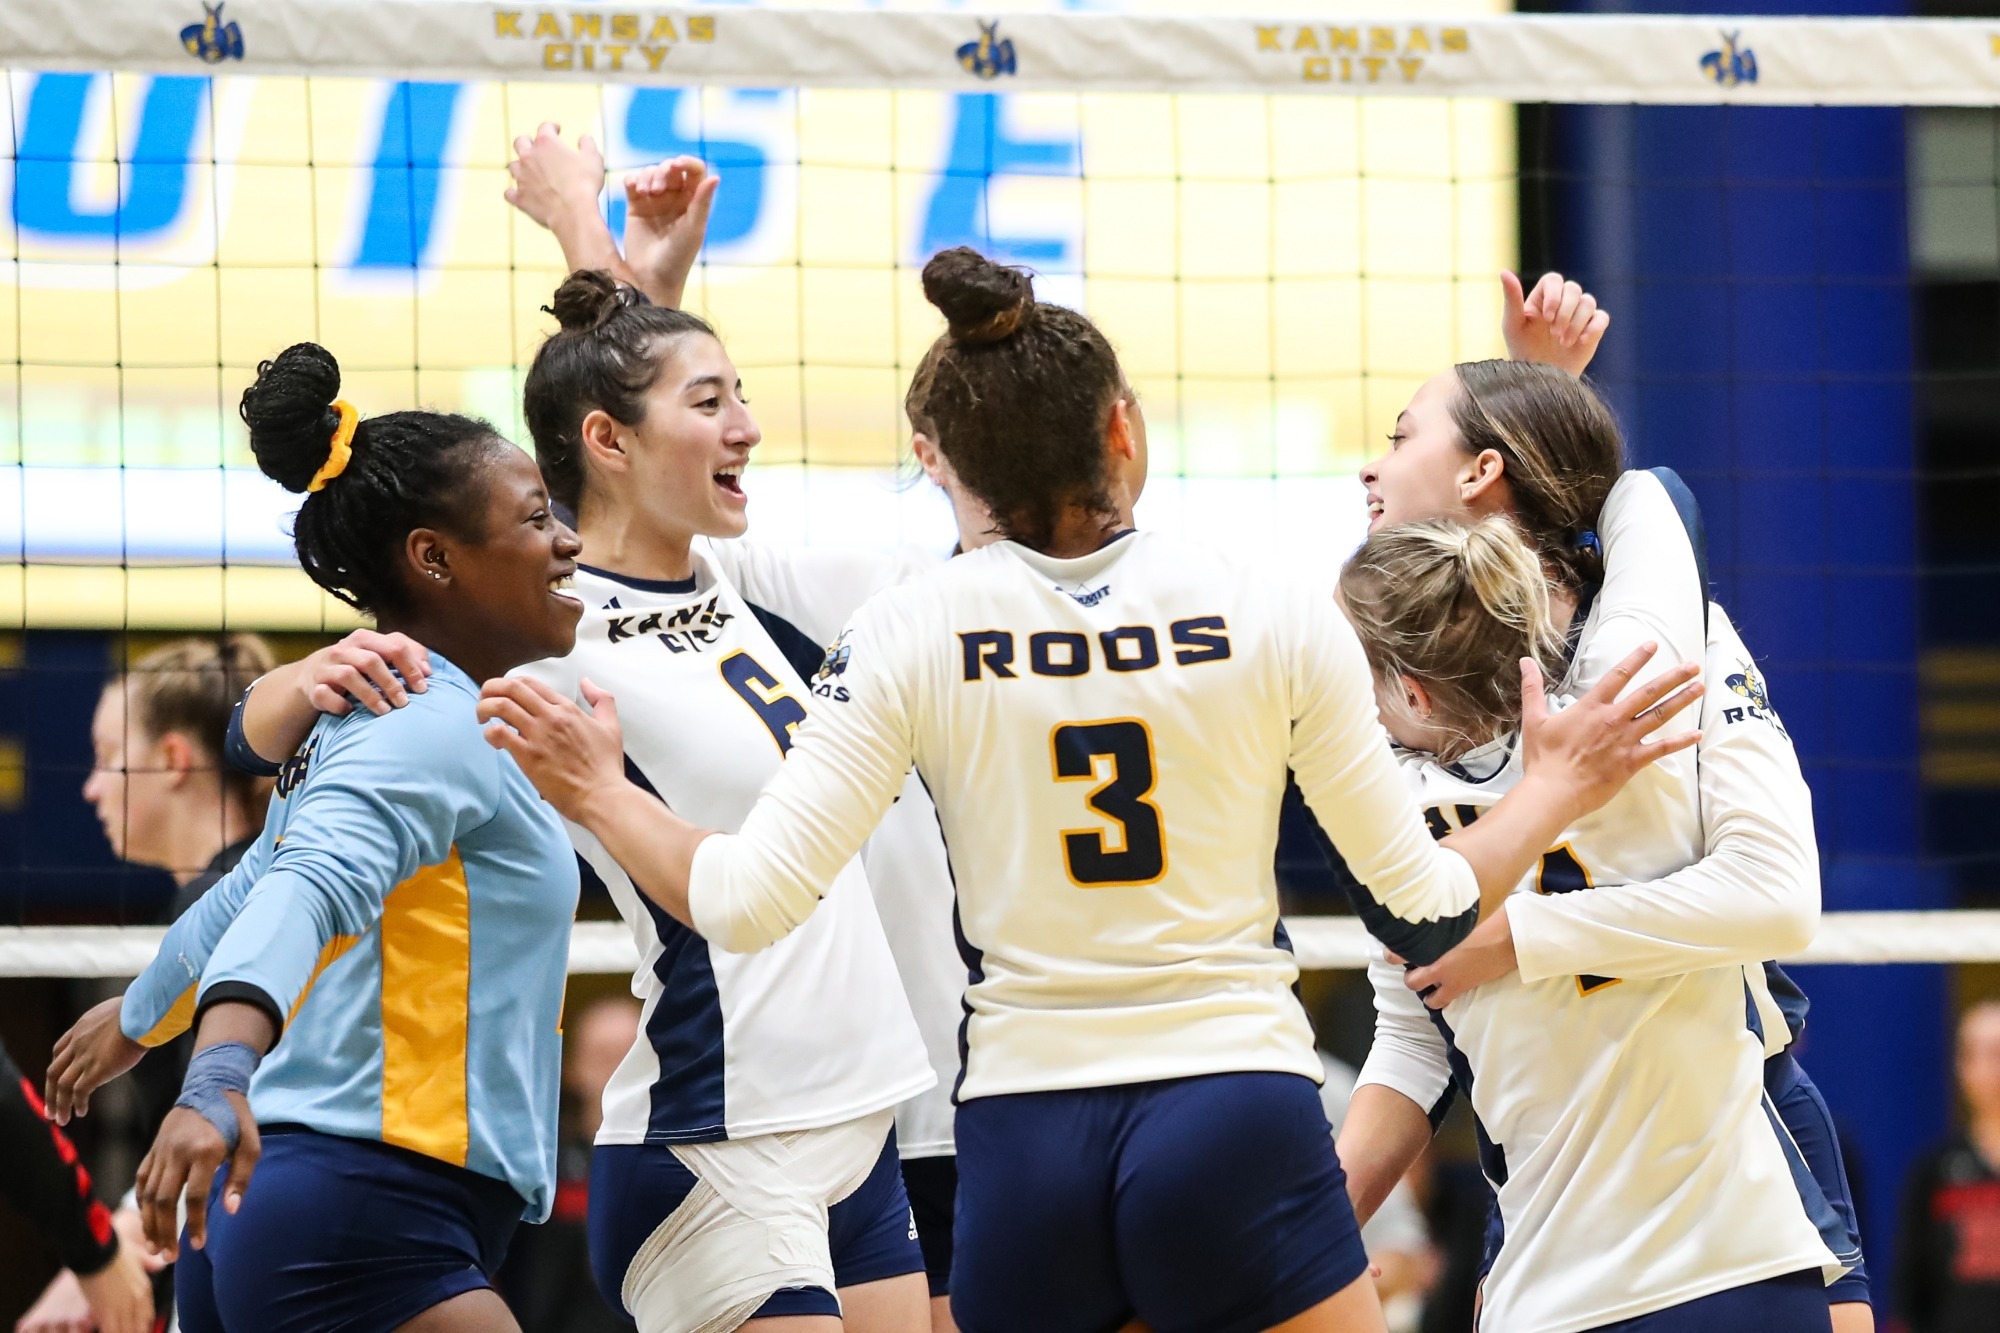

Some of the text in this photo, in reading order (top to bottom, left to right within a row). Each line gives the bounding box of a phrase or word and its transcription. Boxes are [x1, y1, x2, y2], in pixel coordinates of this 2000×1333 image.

[494, 10, 716, 42] KANSAS
[1254, 26, 1470, 54] KANSAS
[543, 43, 671, 71] CITY
[1302, 57, 1424, 82] CITY
[955, 615, 1232, 683] ROOS
[1048, 716, 1169, 889] 3
